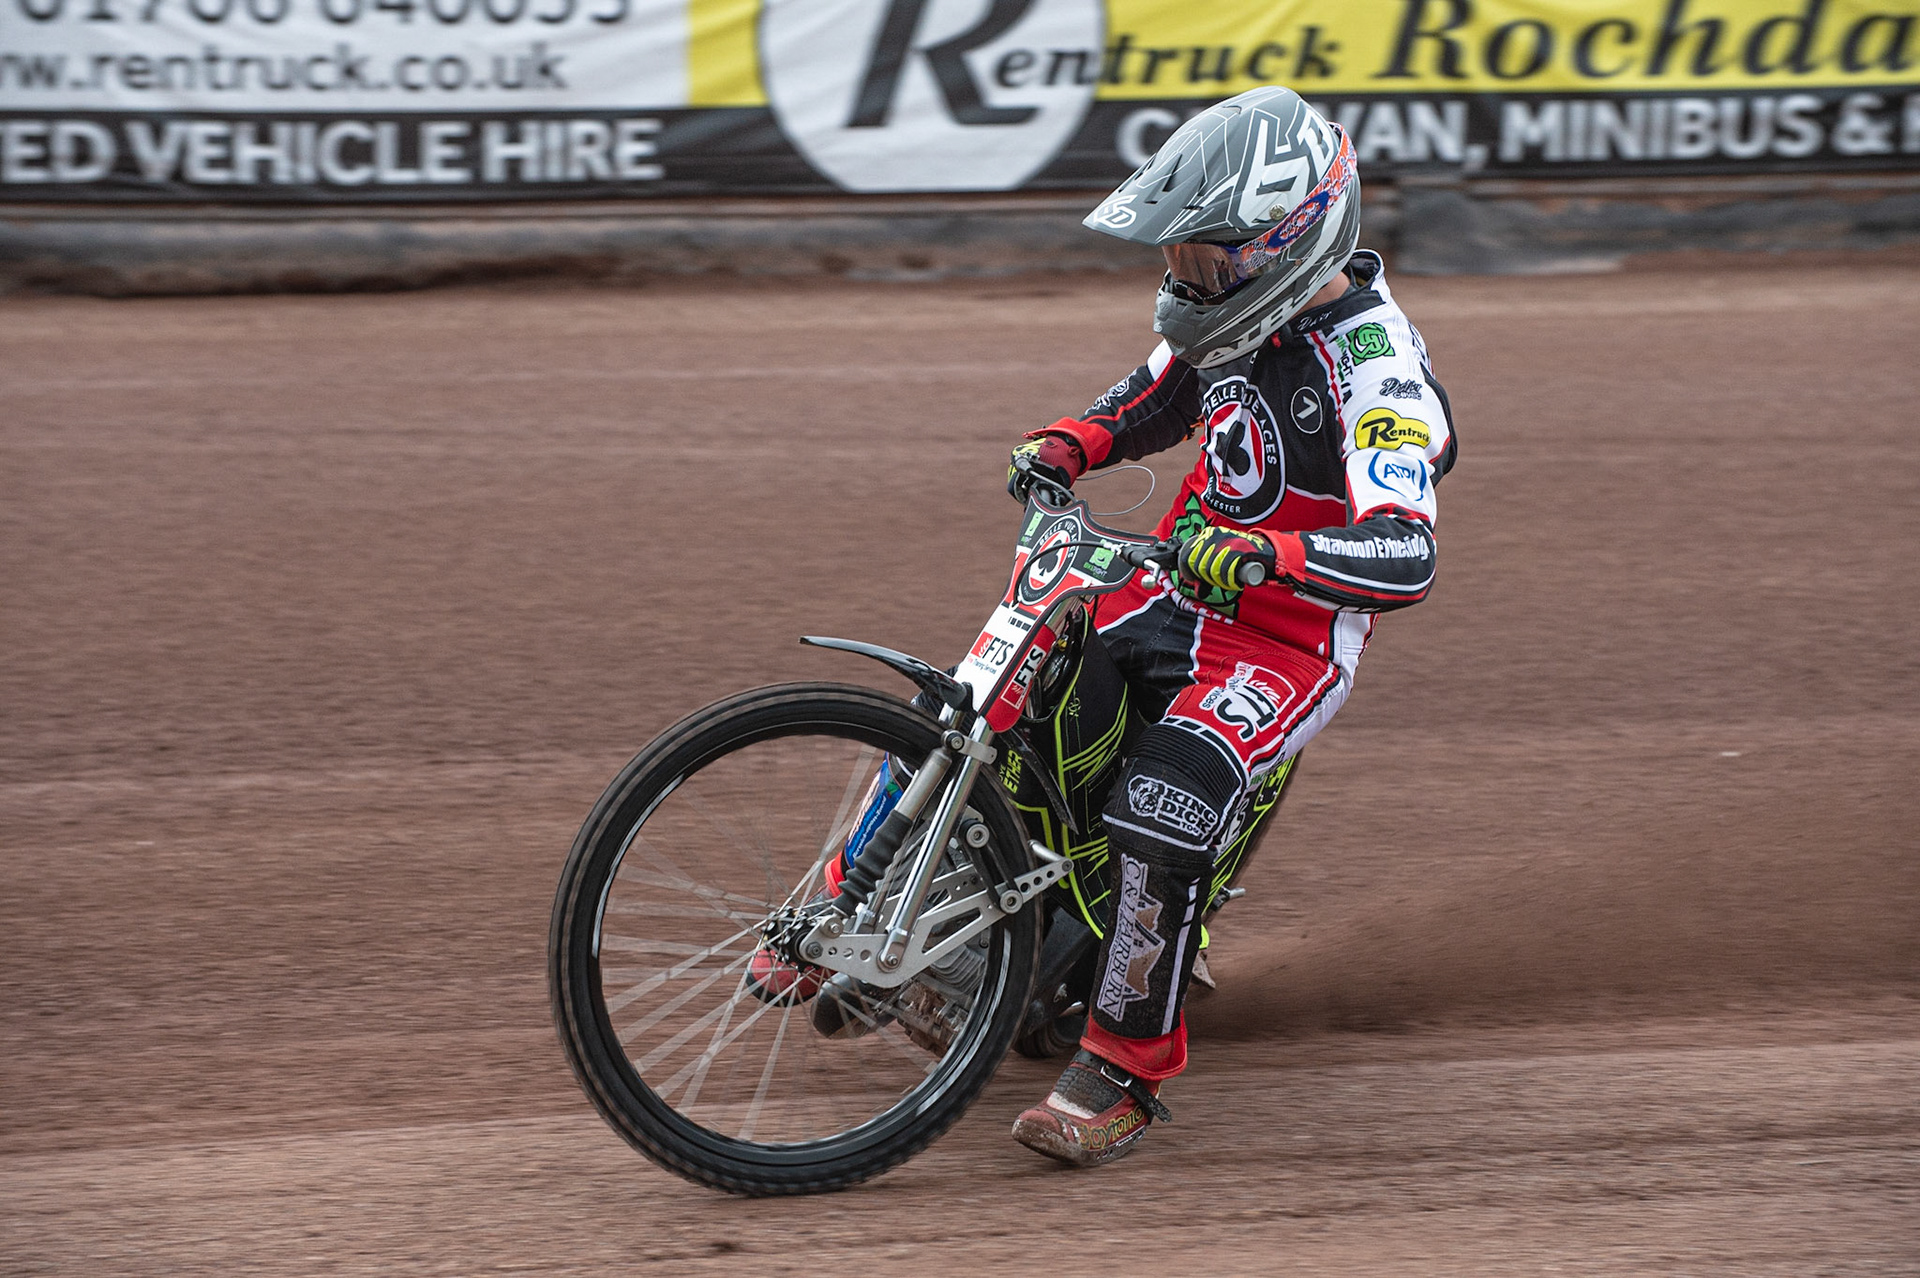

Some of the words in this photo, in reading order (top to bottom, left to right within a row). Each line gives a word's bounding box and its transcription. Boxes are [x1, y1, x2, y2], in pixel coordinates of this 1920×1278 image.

[0, 44, 570, 91] w.rentruck.co.uk
[1499, 97, 1827, 162] MINIBUS
[1833, 92, 1896, 155] &
[2, 119, 115, 184] ED
[126, 119, 474, 186] VEHICLE
[481, 117, 665, 182] HIRE
[1361, 416, 1431, 448] Rentruck
[1308, 533, 1377, 558] Shannon
[982, 636, 1014, 666] FTS
[1013, 648, 1044, 688] FTS
[1160, 800, 1211, 834] DICK
[1164, 787, 1217, 823] KING
[1125, 860, 1142, 880] C
[1125, 880, 1138, 898] &
[1101, 916, 1134, 1016] FAIRBURN
